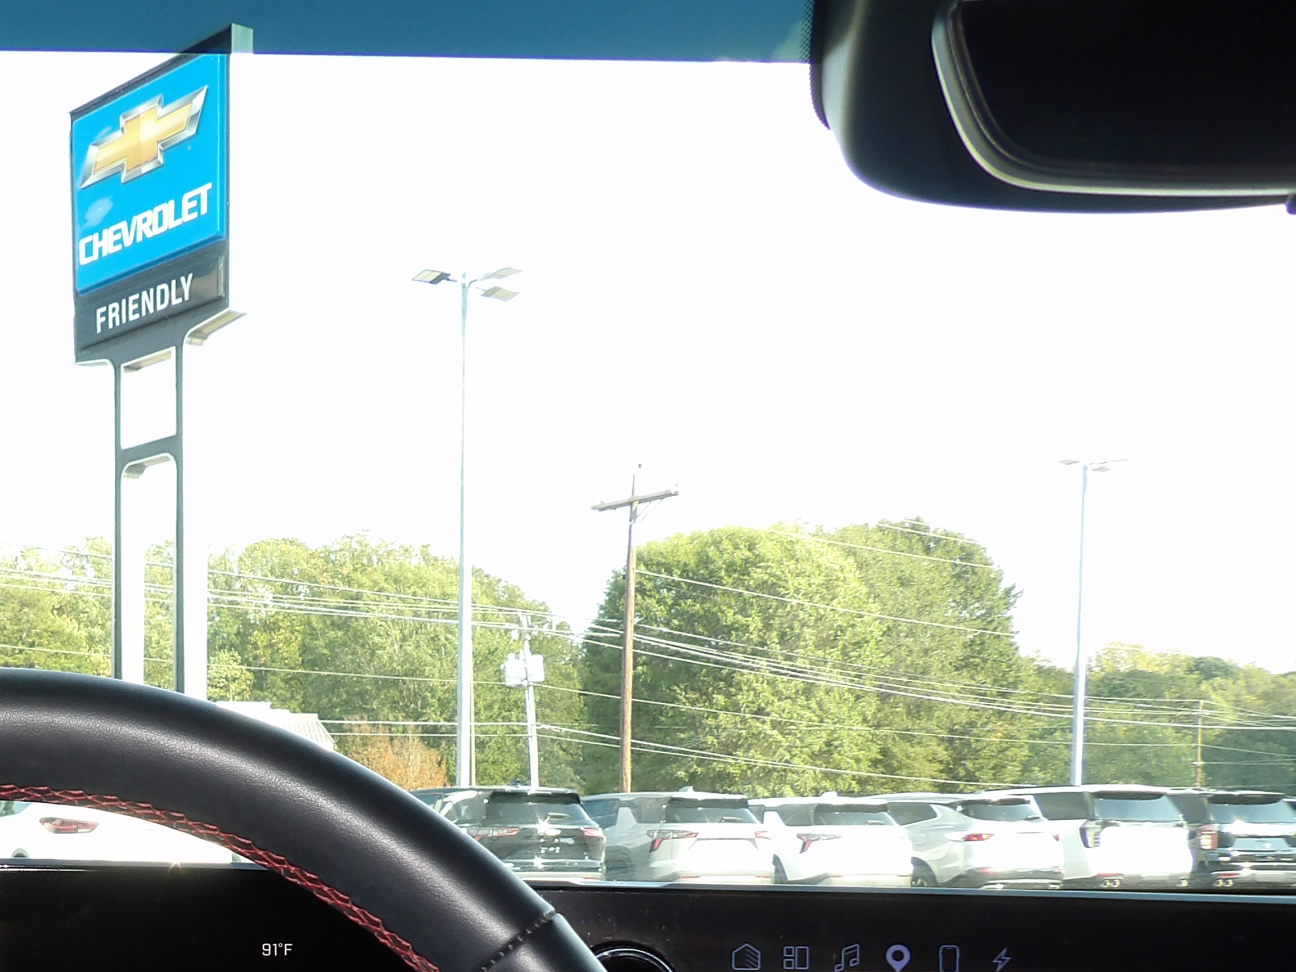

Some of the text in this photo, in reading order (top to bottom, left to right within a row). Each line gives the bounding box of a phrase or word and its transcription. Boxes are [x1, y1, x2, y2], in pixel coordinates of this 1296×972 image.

[78, 183, 213, 266] CHEVROLET
[95, 273, 193, 333] FRIENDLY
[261, 943, 293, 957] 91°F
